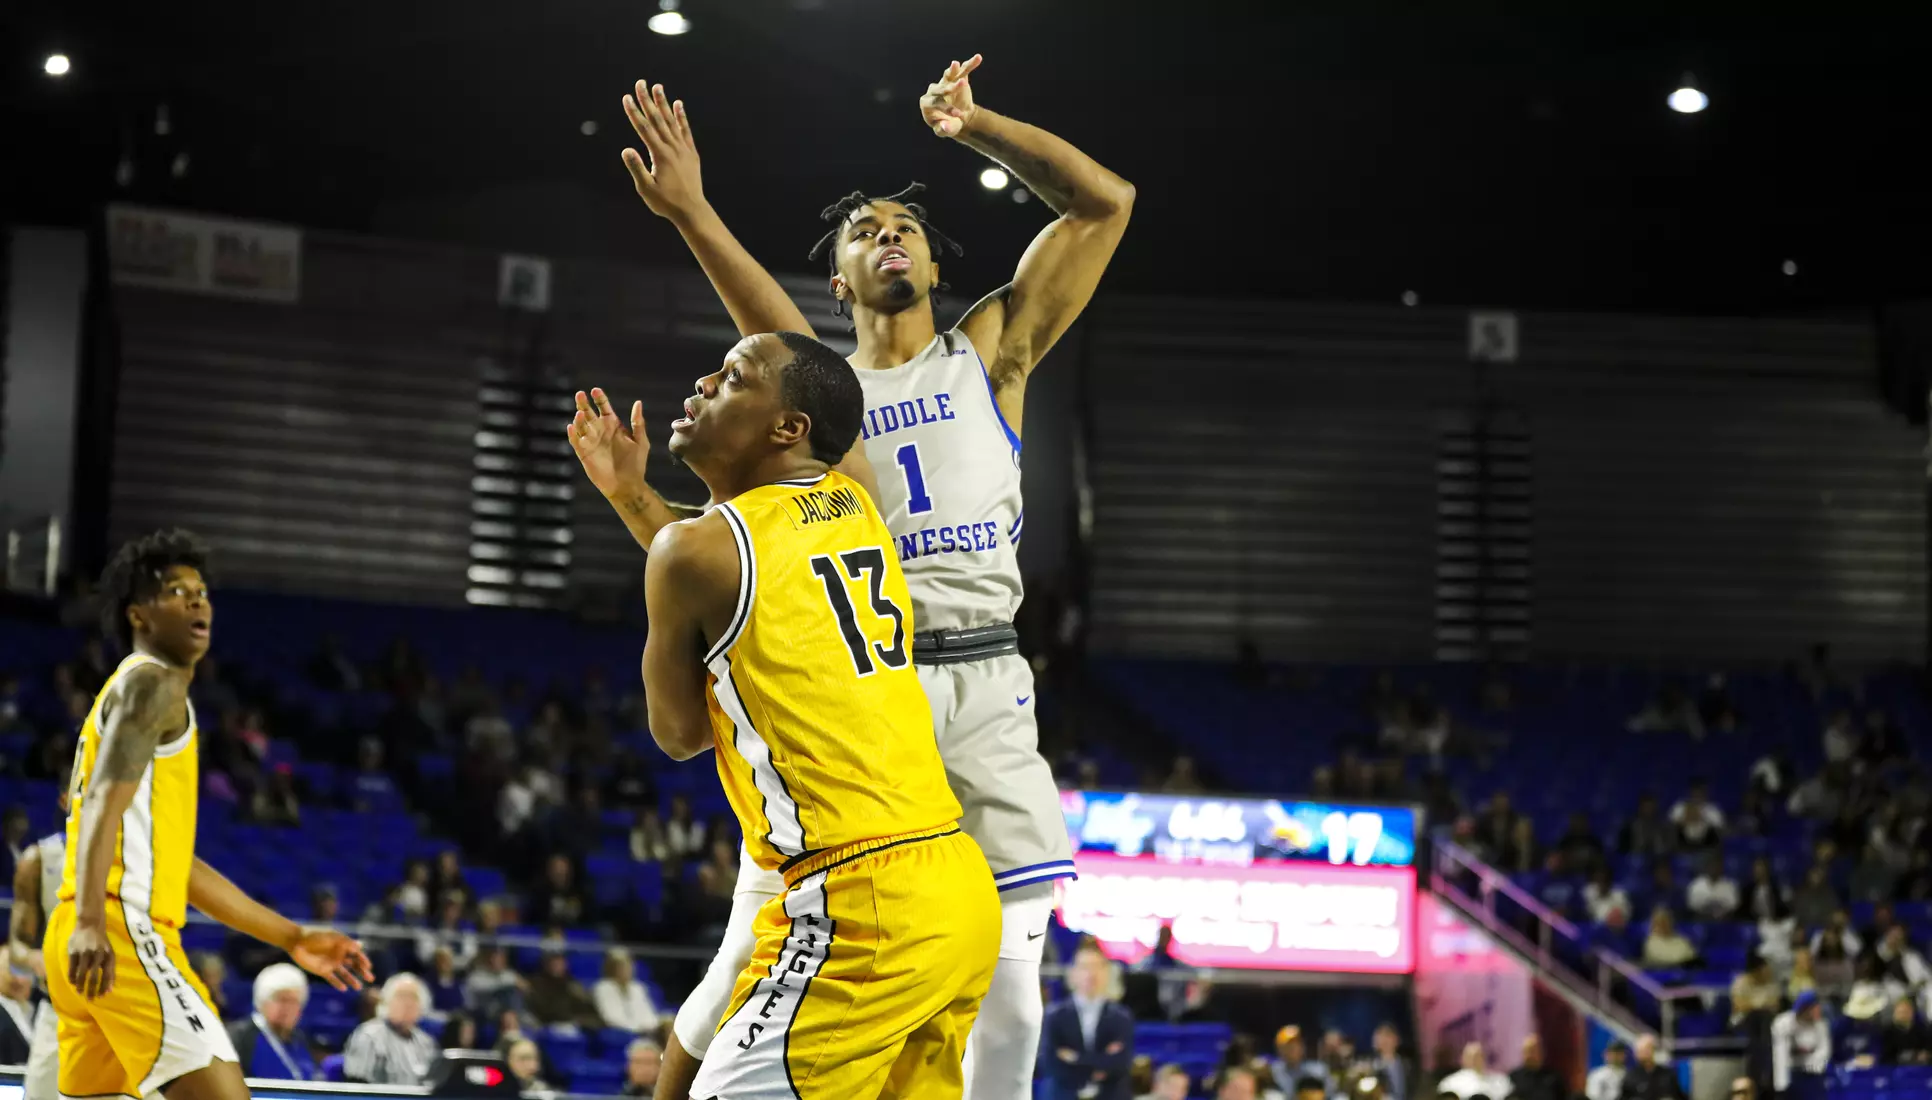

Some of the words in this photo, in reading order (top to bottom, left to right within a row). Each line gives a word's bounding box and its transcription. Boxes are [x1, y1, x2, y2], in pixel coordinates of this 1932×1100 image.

[895, 441, 934, 517] 1
[893, 521, 998, 562] NESSEE
[809, 546, 909, 678] 13
[1321, 811, 1383, 866] 17
